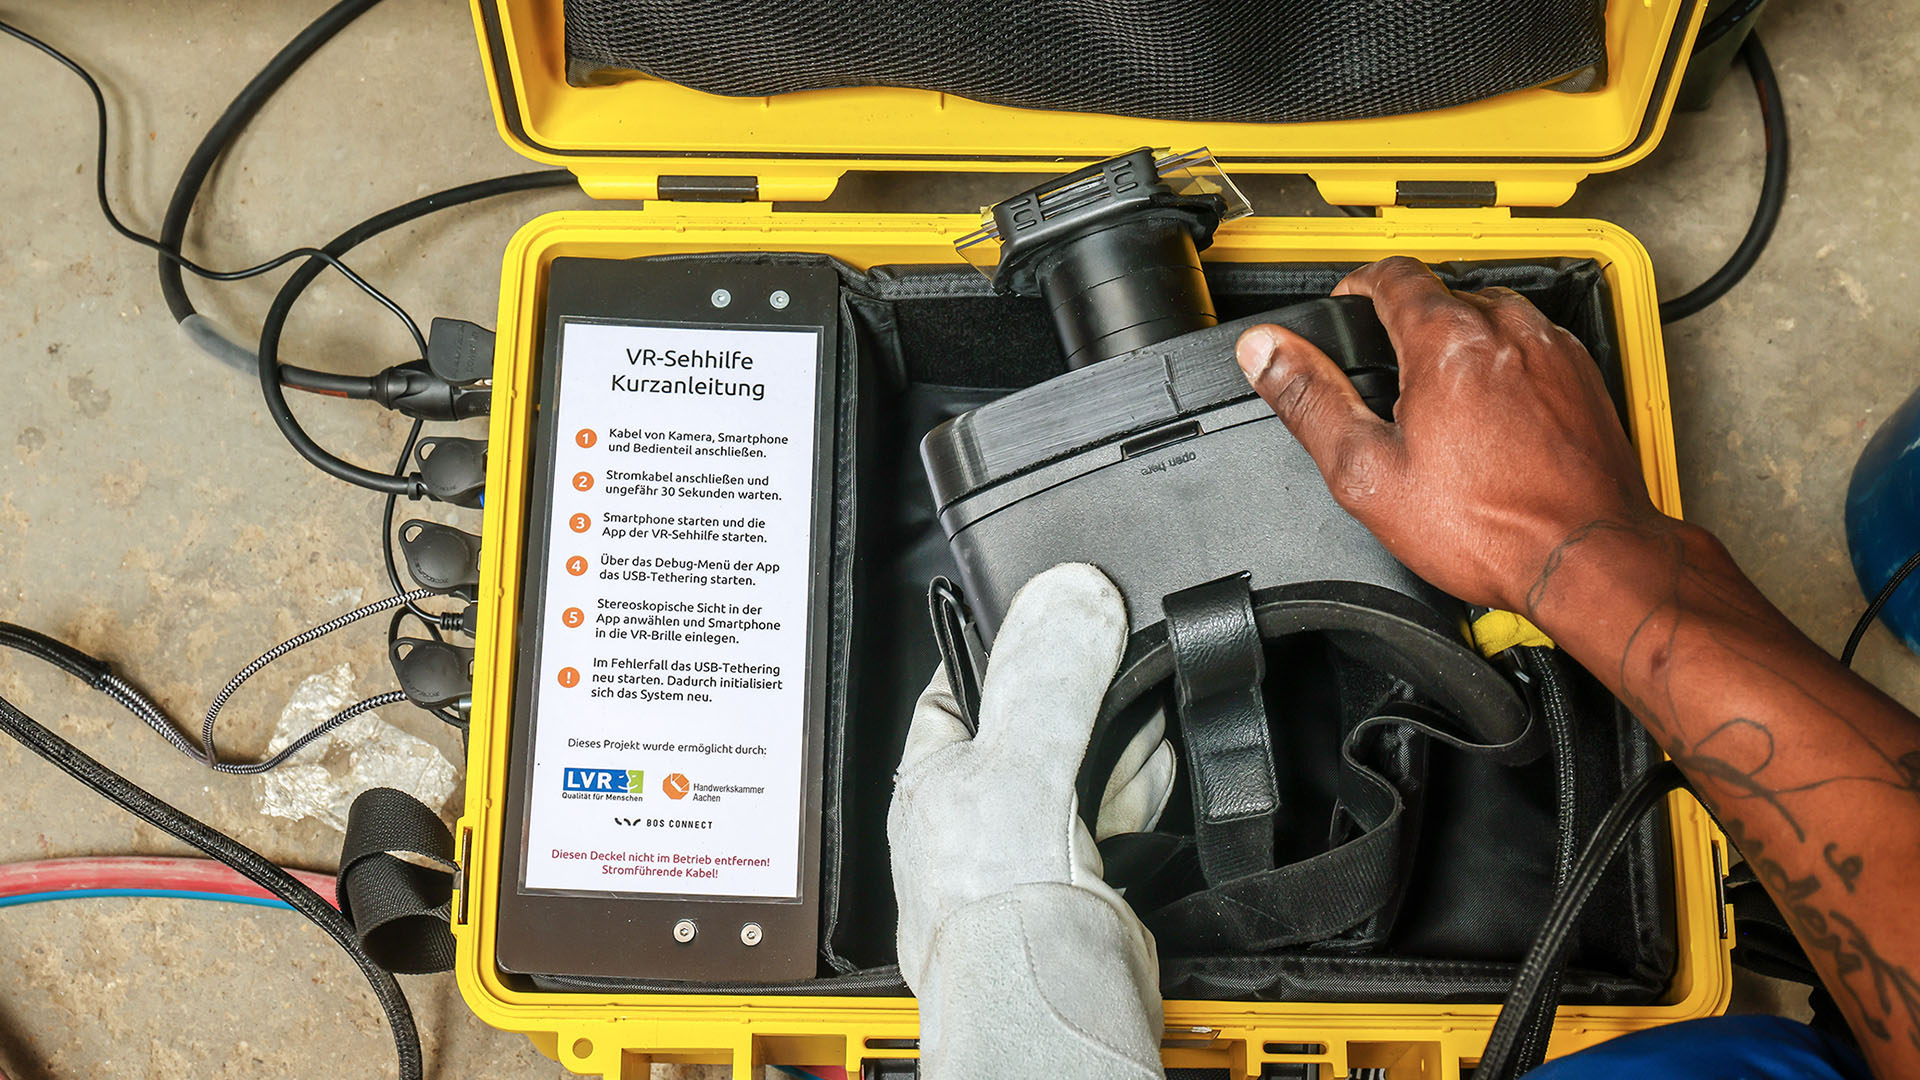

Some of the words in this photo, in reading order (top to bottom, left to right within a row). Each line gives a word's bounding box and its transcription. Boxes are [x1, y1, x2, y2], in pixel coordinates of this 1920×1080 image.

[626, 348, 753, 370] VR-Sehhilfe
[612, 374, 765, 401] Kurzanleitung
[609, 428, 642, 439] Kabel
[644, 432, 665, 440] von
[668, 431, 715, 443] Kamera,
[718, 432, 788, 445] Smartphone
[608, 442, 630, 452] und
[633, 443, 692, 455] Bedienteil
[694, 446, 766, 458] anschließen.
[1168, 451, 1196, 466] open
[1141, 462, 1167, 476] here
[606, 470, 673, 482] Stromkabel
[675, 473, 744, 485] anschließen
[747, 476, 769, 486] und
[605, 484, 658, 496] ungefähr
[661, 486, 675, 497] 30
[678, 487, 735, 499] Sekunden
[738, 490, 782, 501] warten.
[603, 512, 675, 525] Smartphone
[678, 516, 719, 527] starten
[723, 517, 744, 528] und
[747, 518, 766, 529] die
[602, 527, 626, 539] App
[629, 527, 649, 538] der
[651, 529, 719, 541] VR-Sehhilfe
[722, 532, 767, 543] starten.
[601, 553, 630, 566] Über
[632, 556, 652, 567] das
[655, 557, 730, 571] Debug-Menü
[733, 560, 754, 571] der
[756, 562, 780, 574] App
[599, 569, 619, 580] das
[623, 570, 707, 586] USB-Tethering
[710, 575, 756, 586] starten.
[597, 598, 694, 613] Stereoskopische
[697, 603, 726, 614] Sicht
[729, 604, 739, 614] in
[742, 604, 763, 615] der
[596, 613, 620, 626] App
[623, 615, 680, 626] anwählen
[683, 617, 705, 628] und
[708, 618, 781, 631] Smartphone
[595, 627, 606, 638] in
[609, 628, 627, 639] die
[630, 629, 682, 642] VR-Brille
[685, 631, 739, 645] einlegen.
[593, 657, 608, 668] Im
[611, 658, 668, 670] Fehlerfall
[671, 660, 691, 672] das
[694, 662, 780, 677] USB-Tethering
[592, 674, 614, 683] neu
[617, 674, 664, 685] starten.
[667, 675, 717, 687] Dadurch
[720, 677, 783, 690] initialisiert
[591, 687, 614, 698] sich
[617, 687, 637, 699] das
[640, 689, 684, 702] System
[687, 693, 712, 702] neu.
[568, 738, 601, 748] Dieses
[603, 739, 640, 751] Projekt
[642, 742, 675, 751] wurde
[678, 743, 733, 755] ermöglicht
[735, 744, 767, 755] durch:
[566, 770, 612, 789] LVR
[562, 792, 591, 800] Qualität
[606, 794, 643, 802] Menschen
[693, 783, 764, 794] Handwerkskammer
[693, 793, 721, 802] Aachen
[646, 819, 665, 828] BOS
[669, 819, 712, 829] CONNECT
[552, 849, 587, 860] Diesen
[590, 851, 626, 861] Deckel
[628, 852, 654, 863] nicht
[657, 853, 670, 863] im
[673, 854, 712, 865] Betrieb
[714, 856, 770, 867] entfernen!
[602, 865, 683, 877] Stromführende
[686, 868, 718, 878] Kabel!
